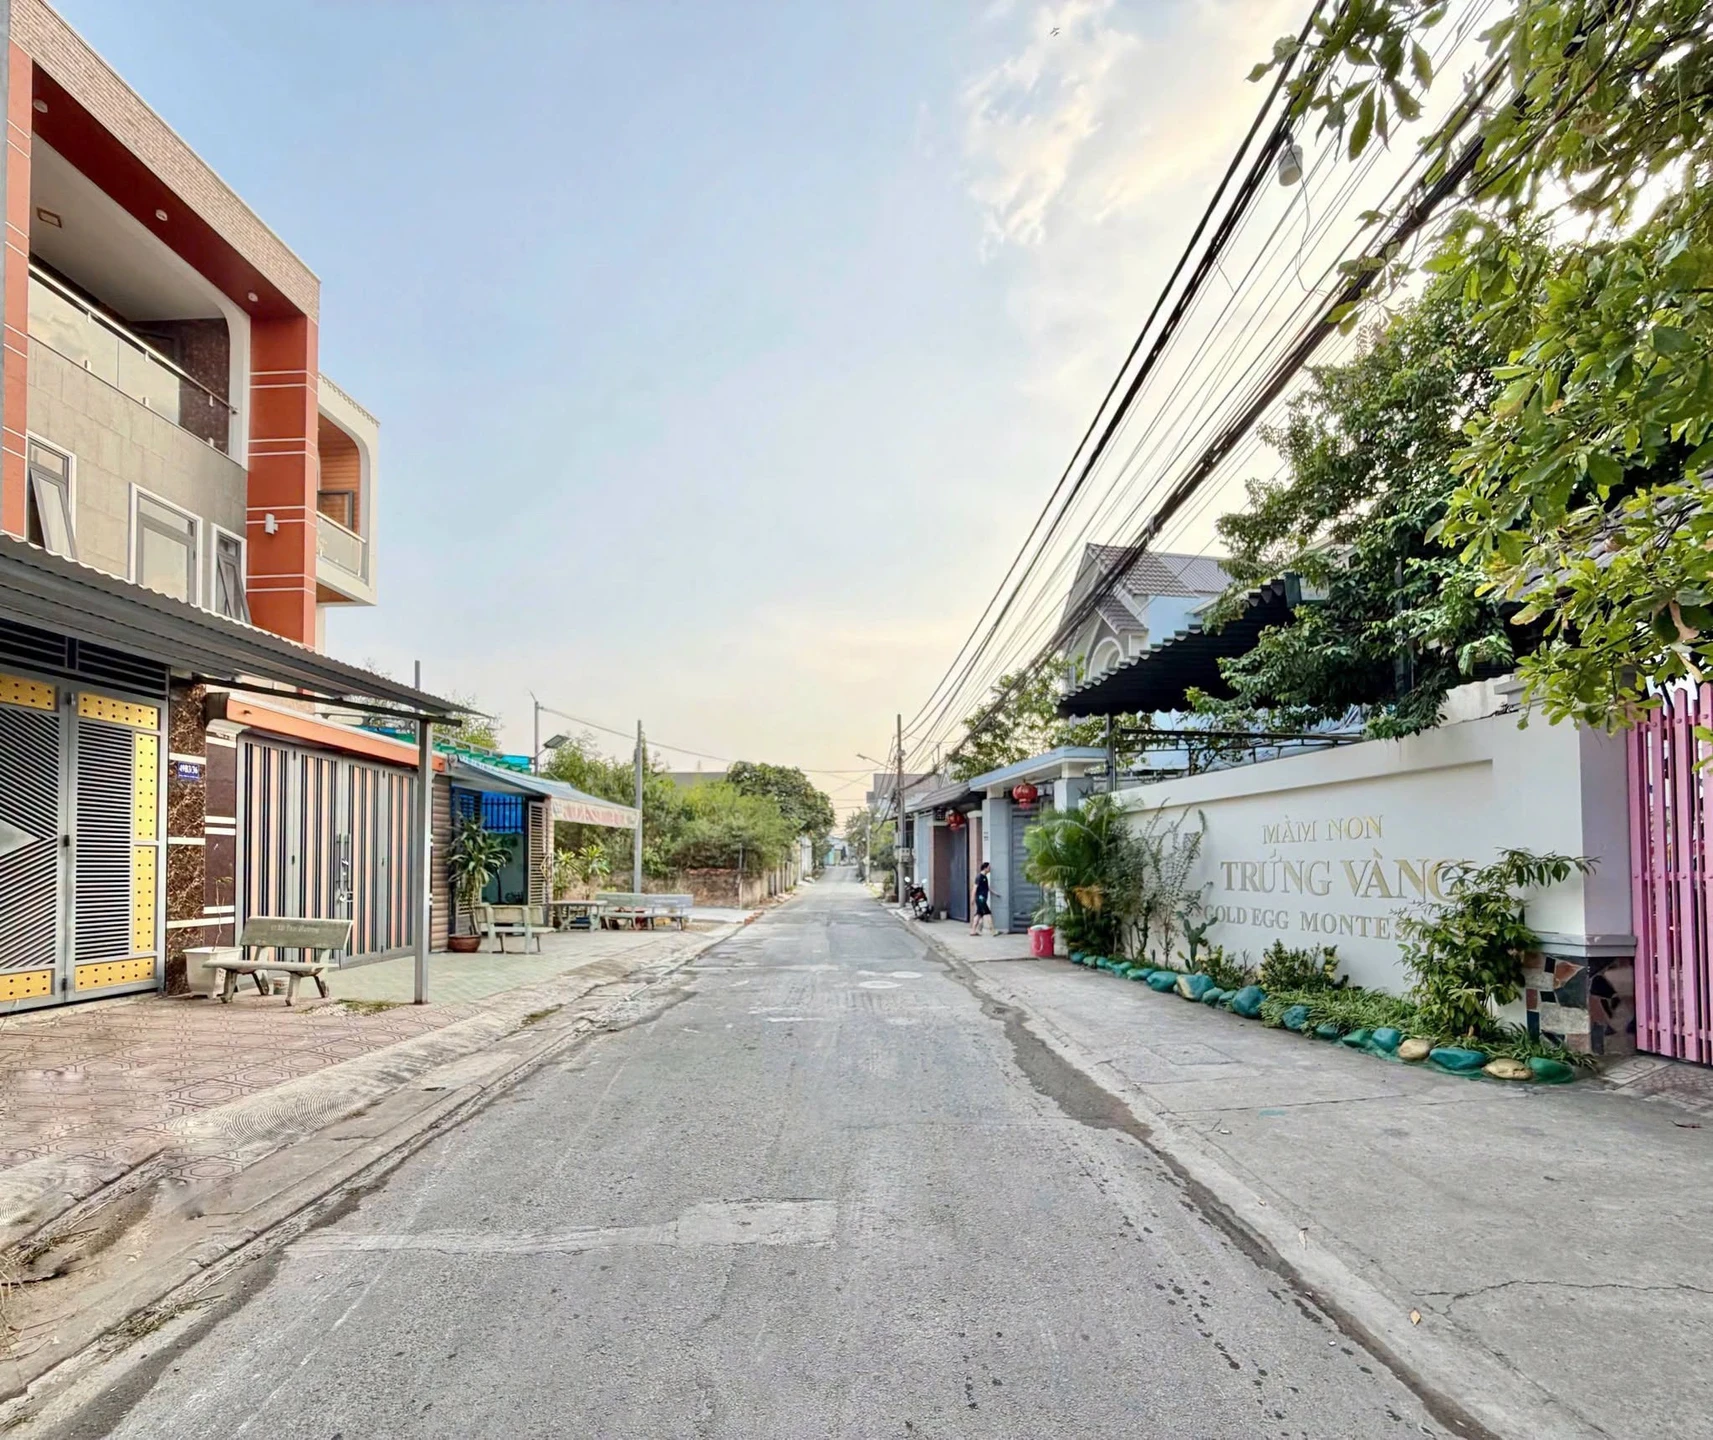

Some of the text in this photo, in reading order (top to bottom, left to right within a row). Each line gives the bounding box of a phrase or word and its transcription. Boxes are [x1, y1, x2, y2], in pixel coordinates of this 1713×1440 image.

[1325, 815, 1384, 841] NON
[1220, 848, 1332, 896] TRỨNG
[1203, 904, 1247, 925] GOLD
[1251, 907, 1289, 929] EGG
